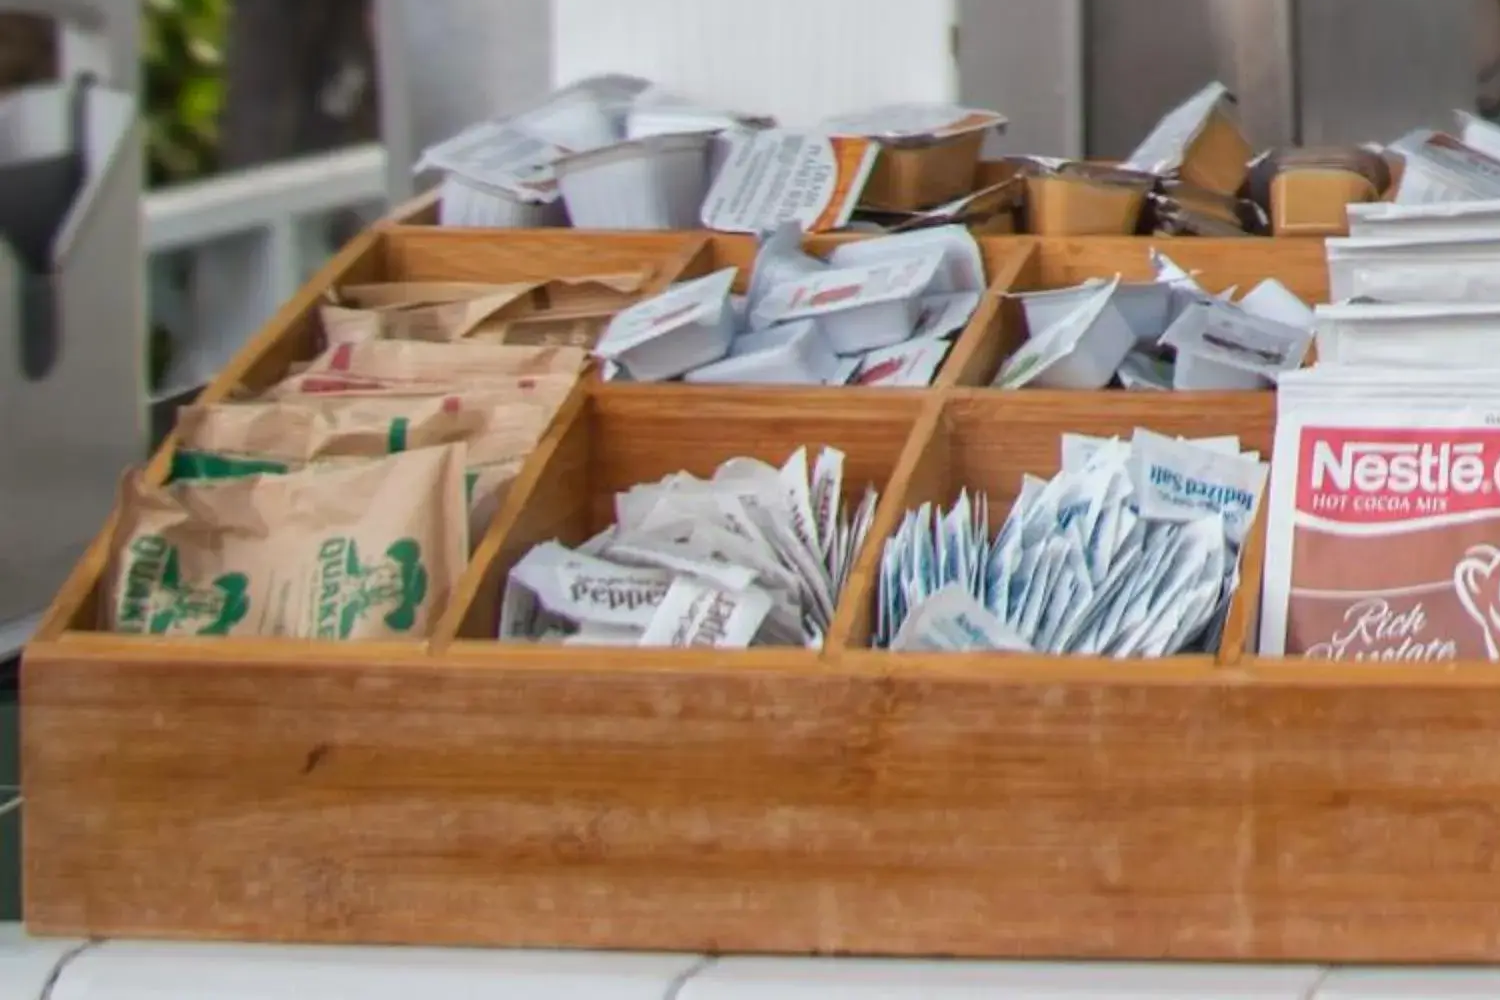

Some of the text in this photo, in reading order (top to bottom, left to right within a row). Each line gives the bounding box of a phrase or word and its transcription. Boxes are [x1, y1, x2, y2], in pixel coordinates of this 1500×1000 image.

[1150, 463, 1182, 492] Salt
[1312, 494, 1448, 512] HOT COCOA MIX
[317, 536, 347, 638] QUAKE
[569, 583, 667, 611] Peppe
[1331, 597, 1428, 645] Rich
